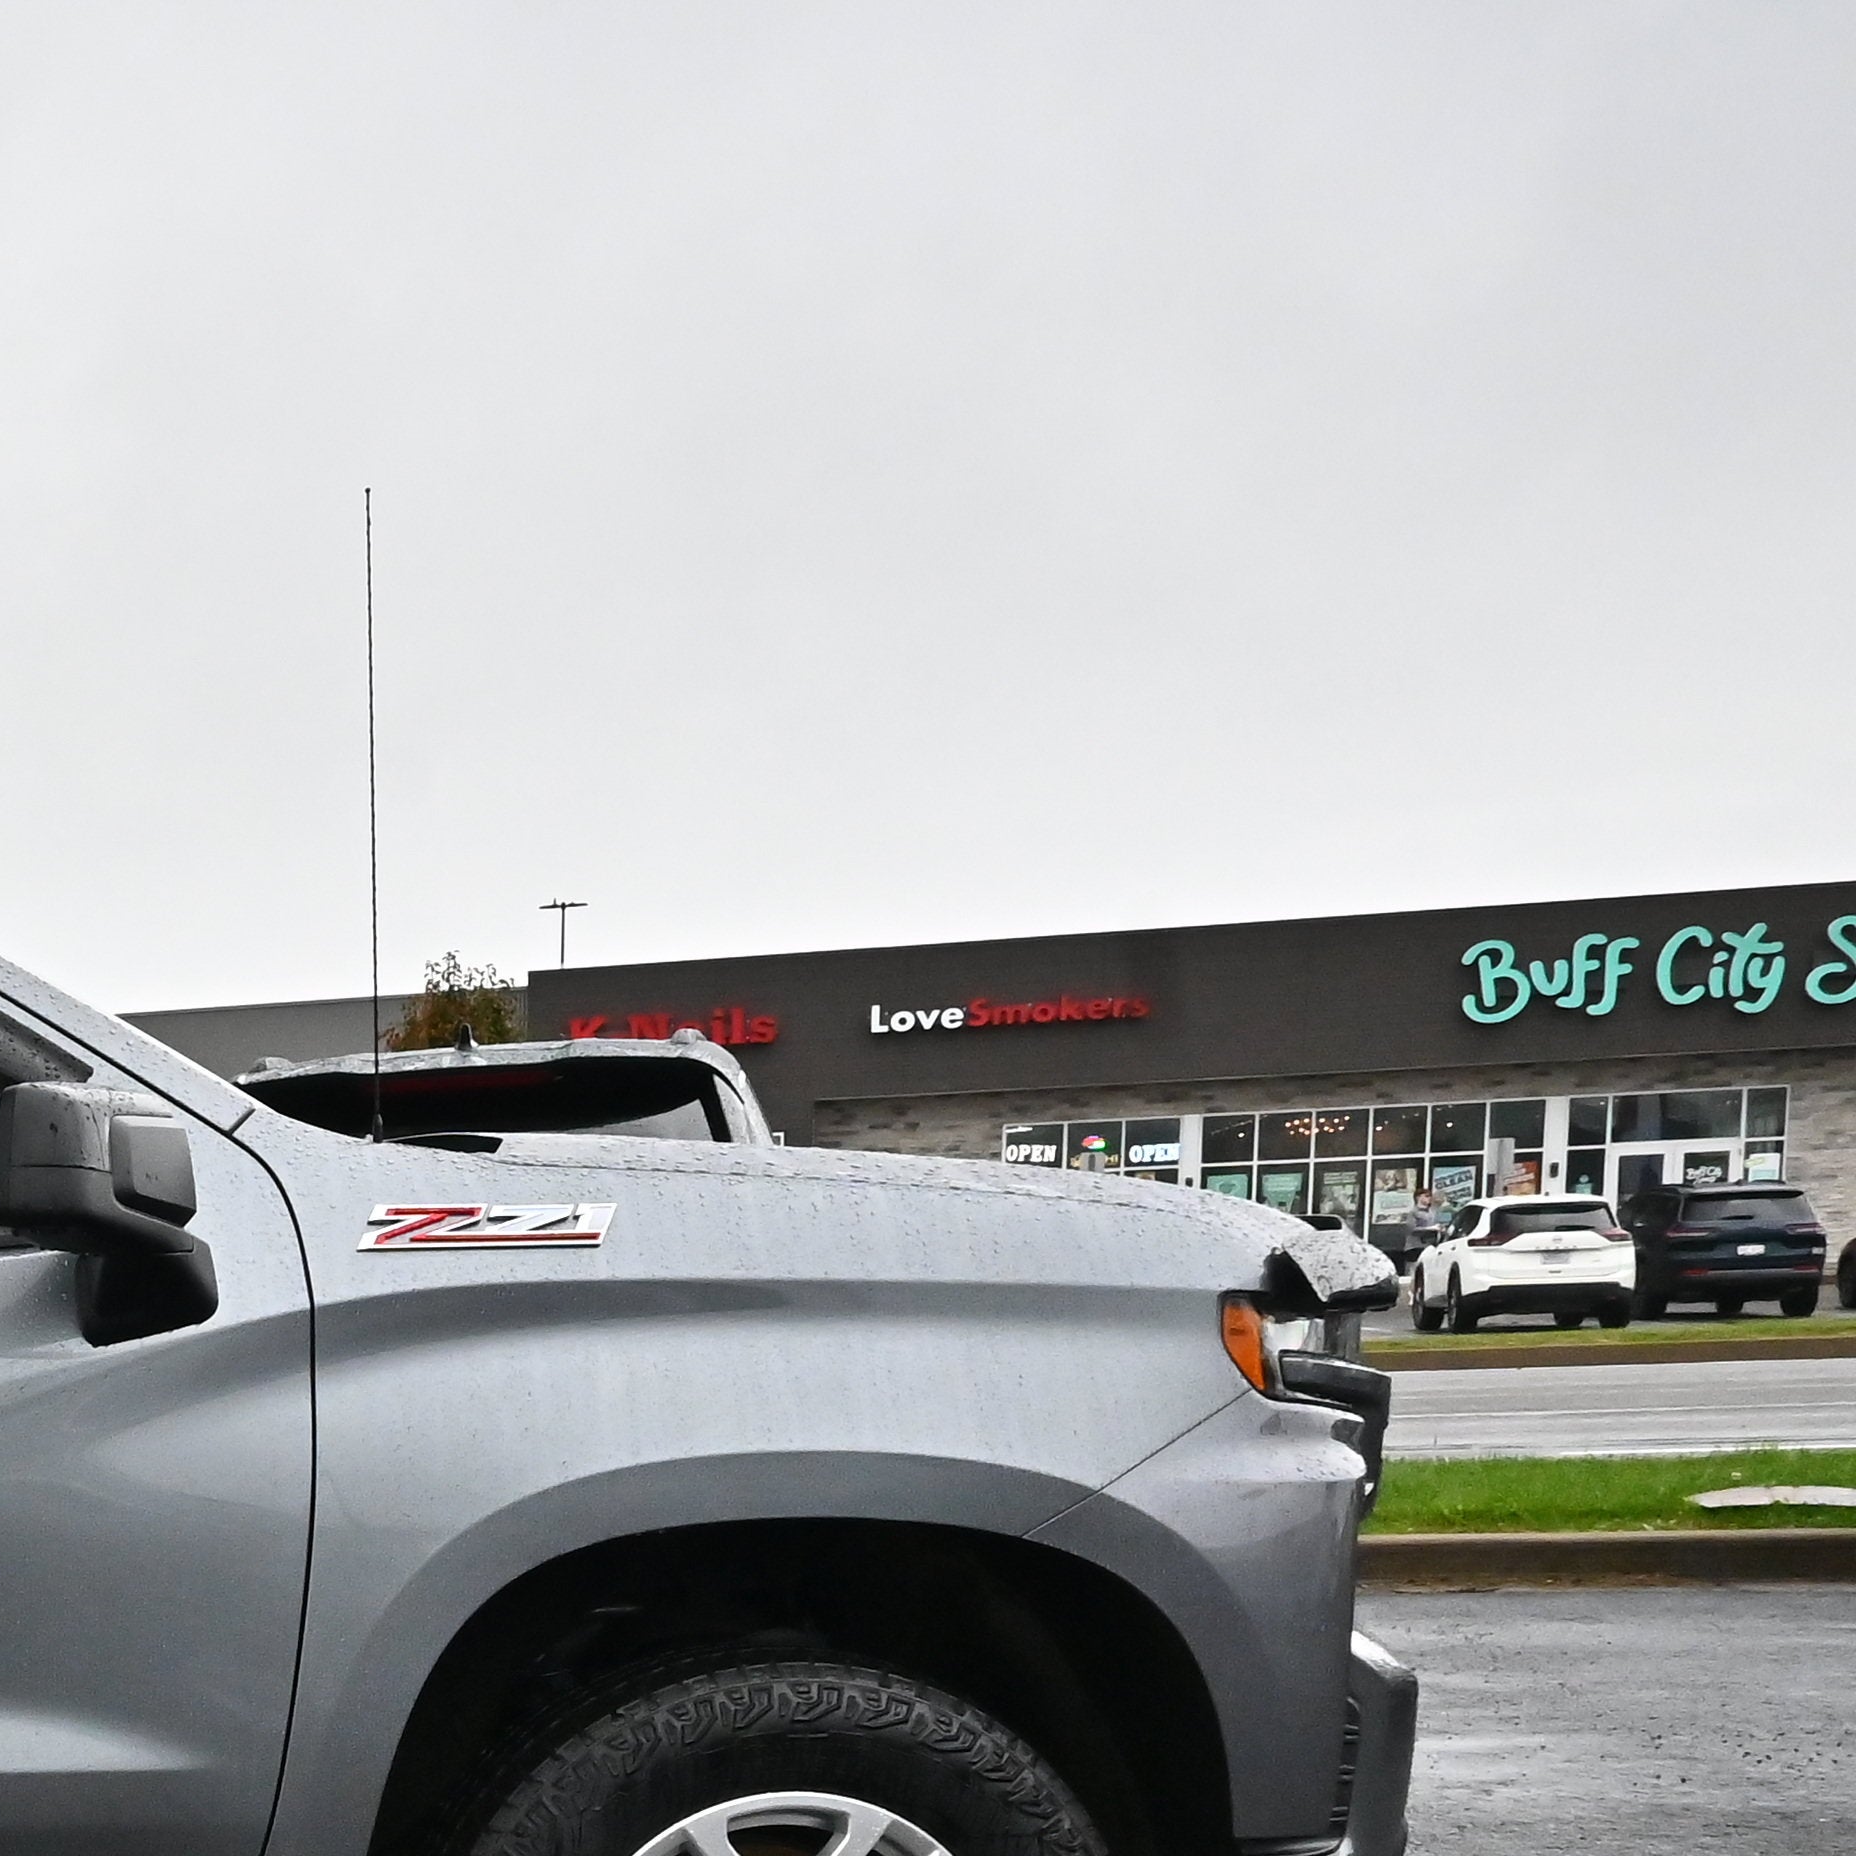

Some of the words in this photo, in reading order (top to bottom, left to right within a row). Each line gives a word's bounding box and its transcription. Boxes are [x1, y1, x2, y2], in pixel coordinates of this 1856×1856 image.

[1461, 932, 1640, 1024] Buff
[1656, 922, 1786, 1014] City
[1006, 1144, 1057, 1162] OPEN
[1129, 1142, 1181, 1163] OPEN
[356, 1202, 618, 1252] Z71
